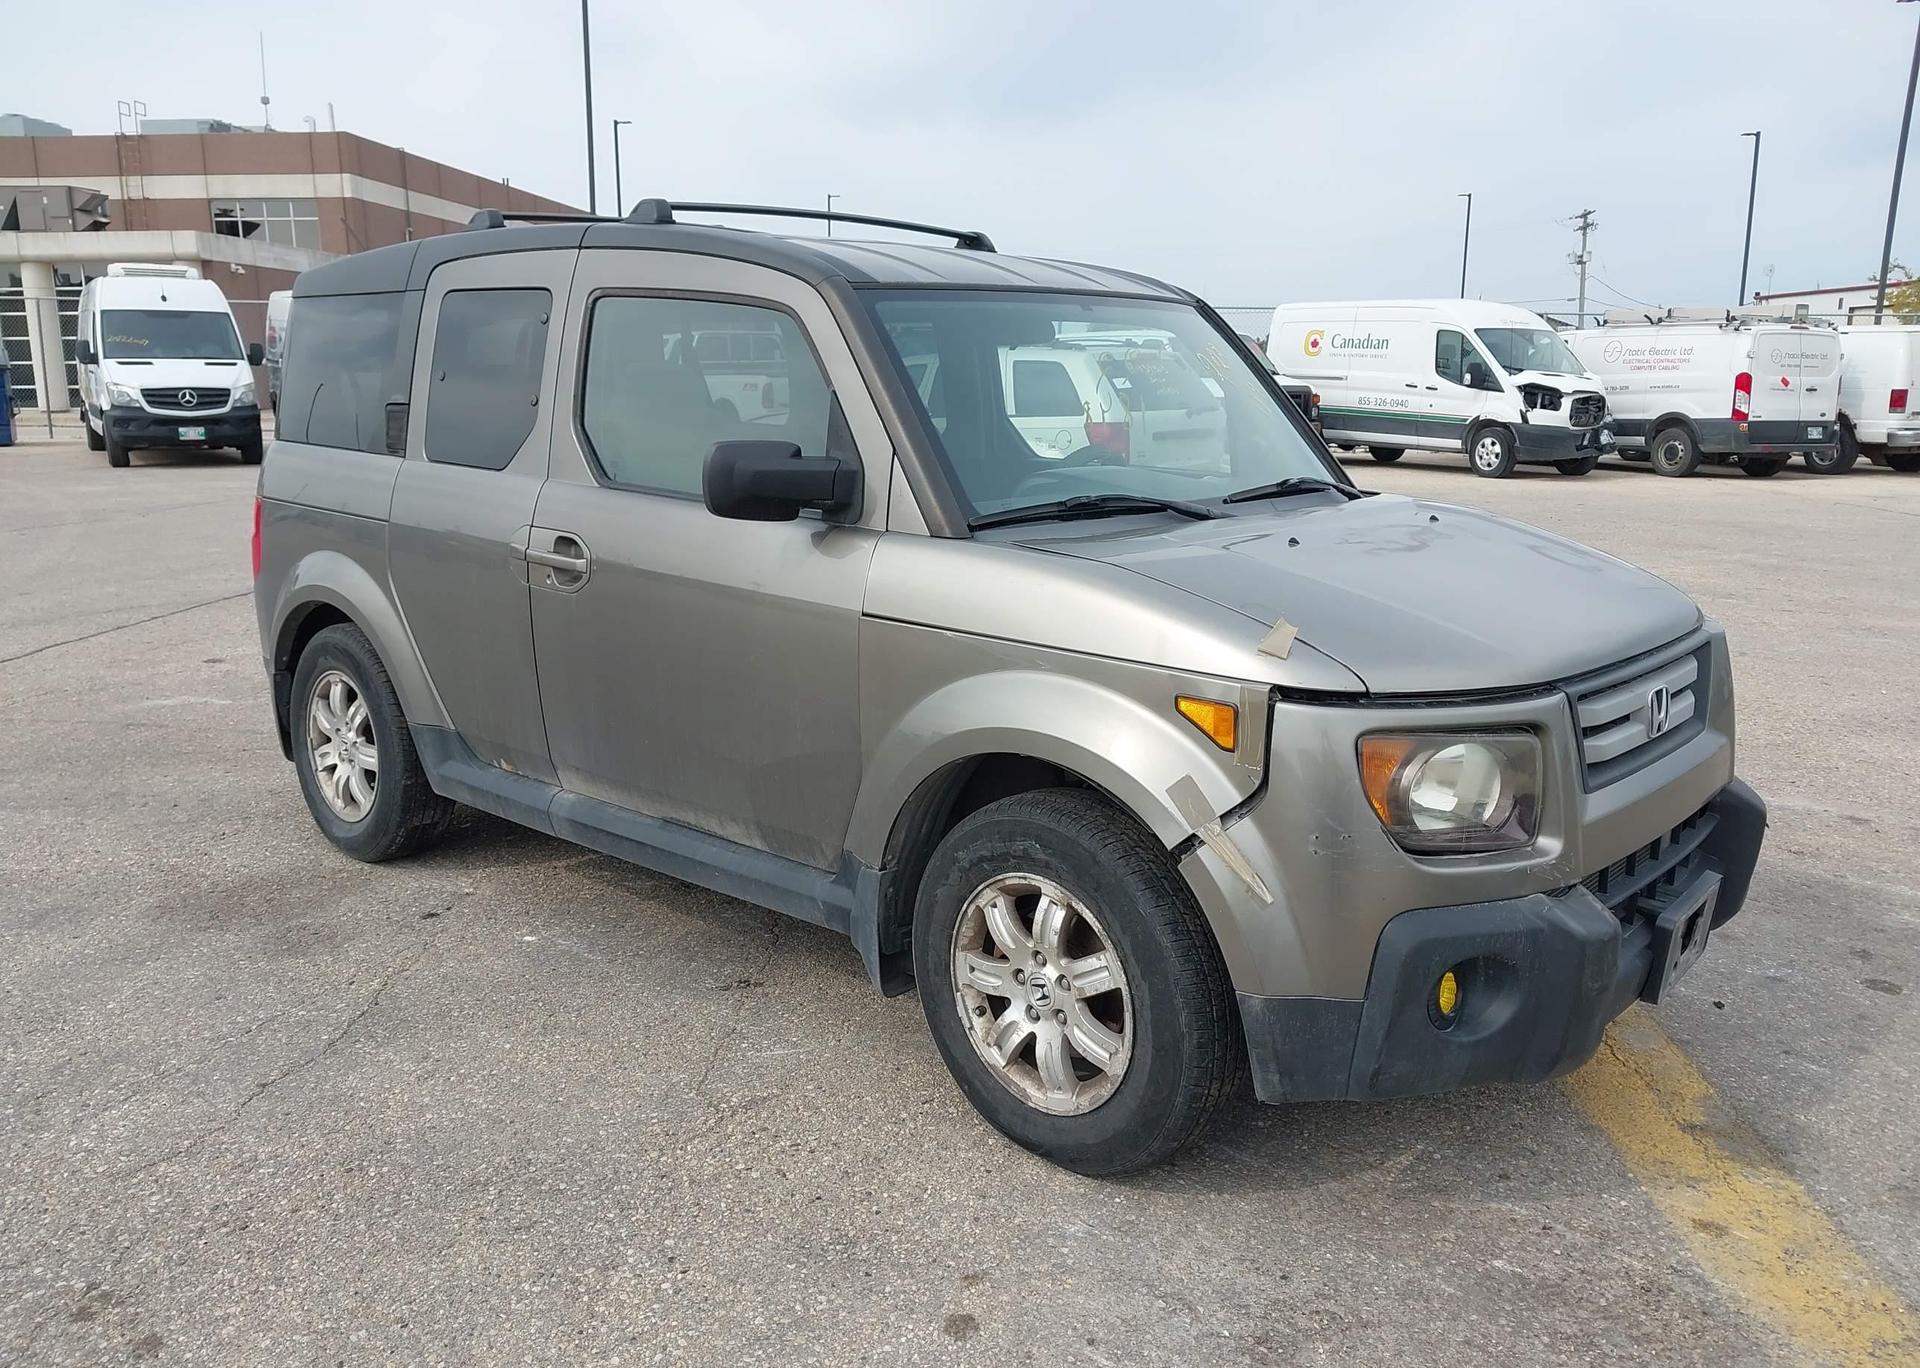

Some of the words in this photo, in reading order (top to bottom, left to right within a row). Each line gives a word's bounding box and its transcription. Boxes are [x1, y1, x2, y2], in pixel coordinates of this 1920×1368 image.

[1331, 333, 1389, 350] Canadian
[1622, 348, 1646, 357] Static
[1648, 347, 1678, 356] Electric
[1679, 346, 1694, 356] Ltd.
[1358, 396, 1410, 408] 855-326-0940
